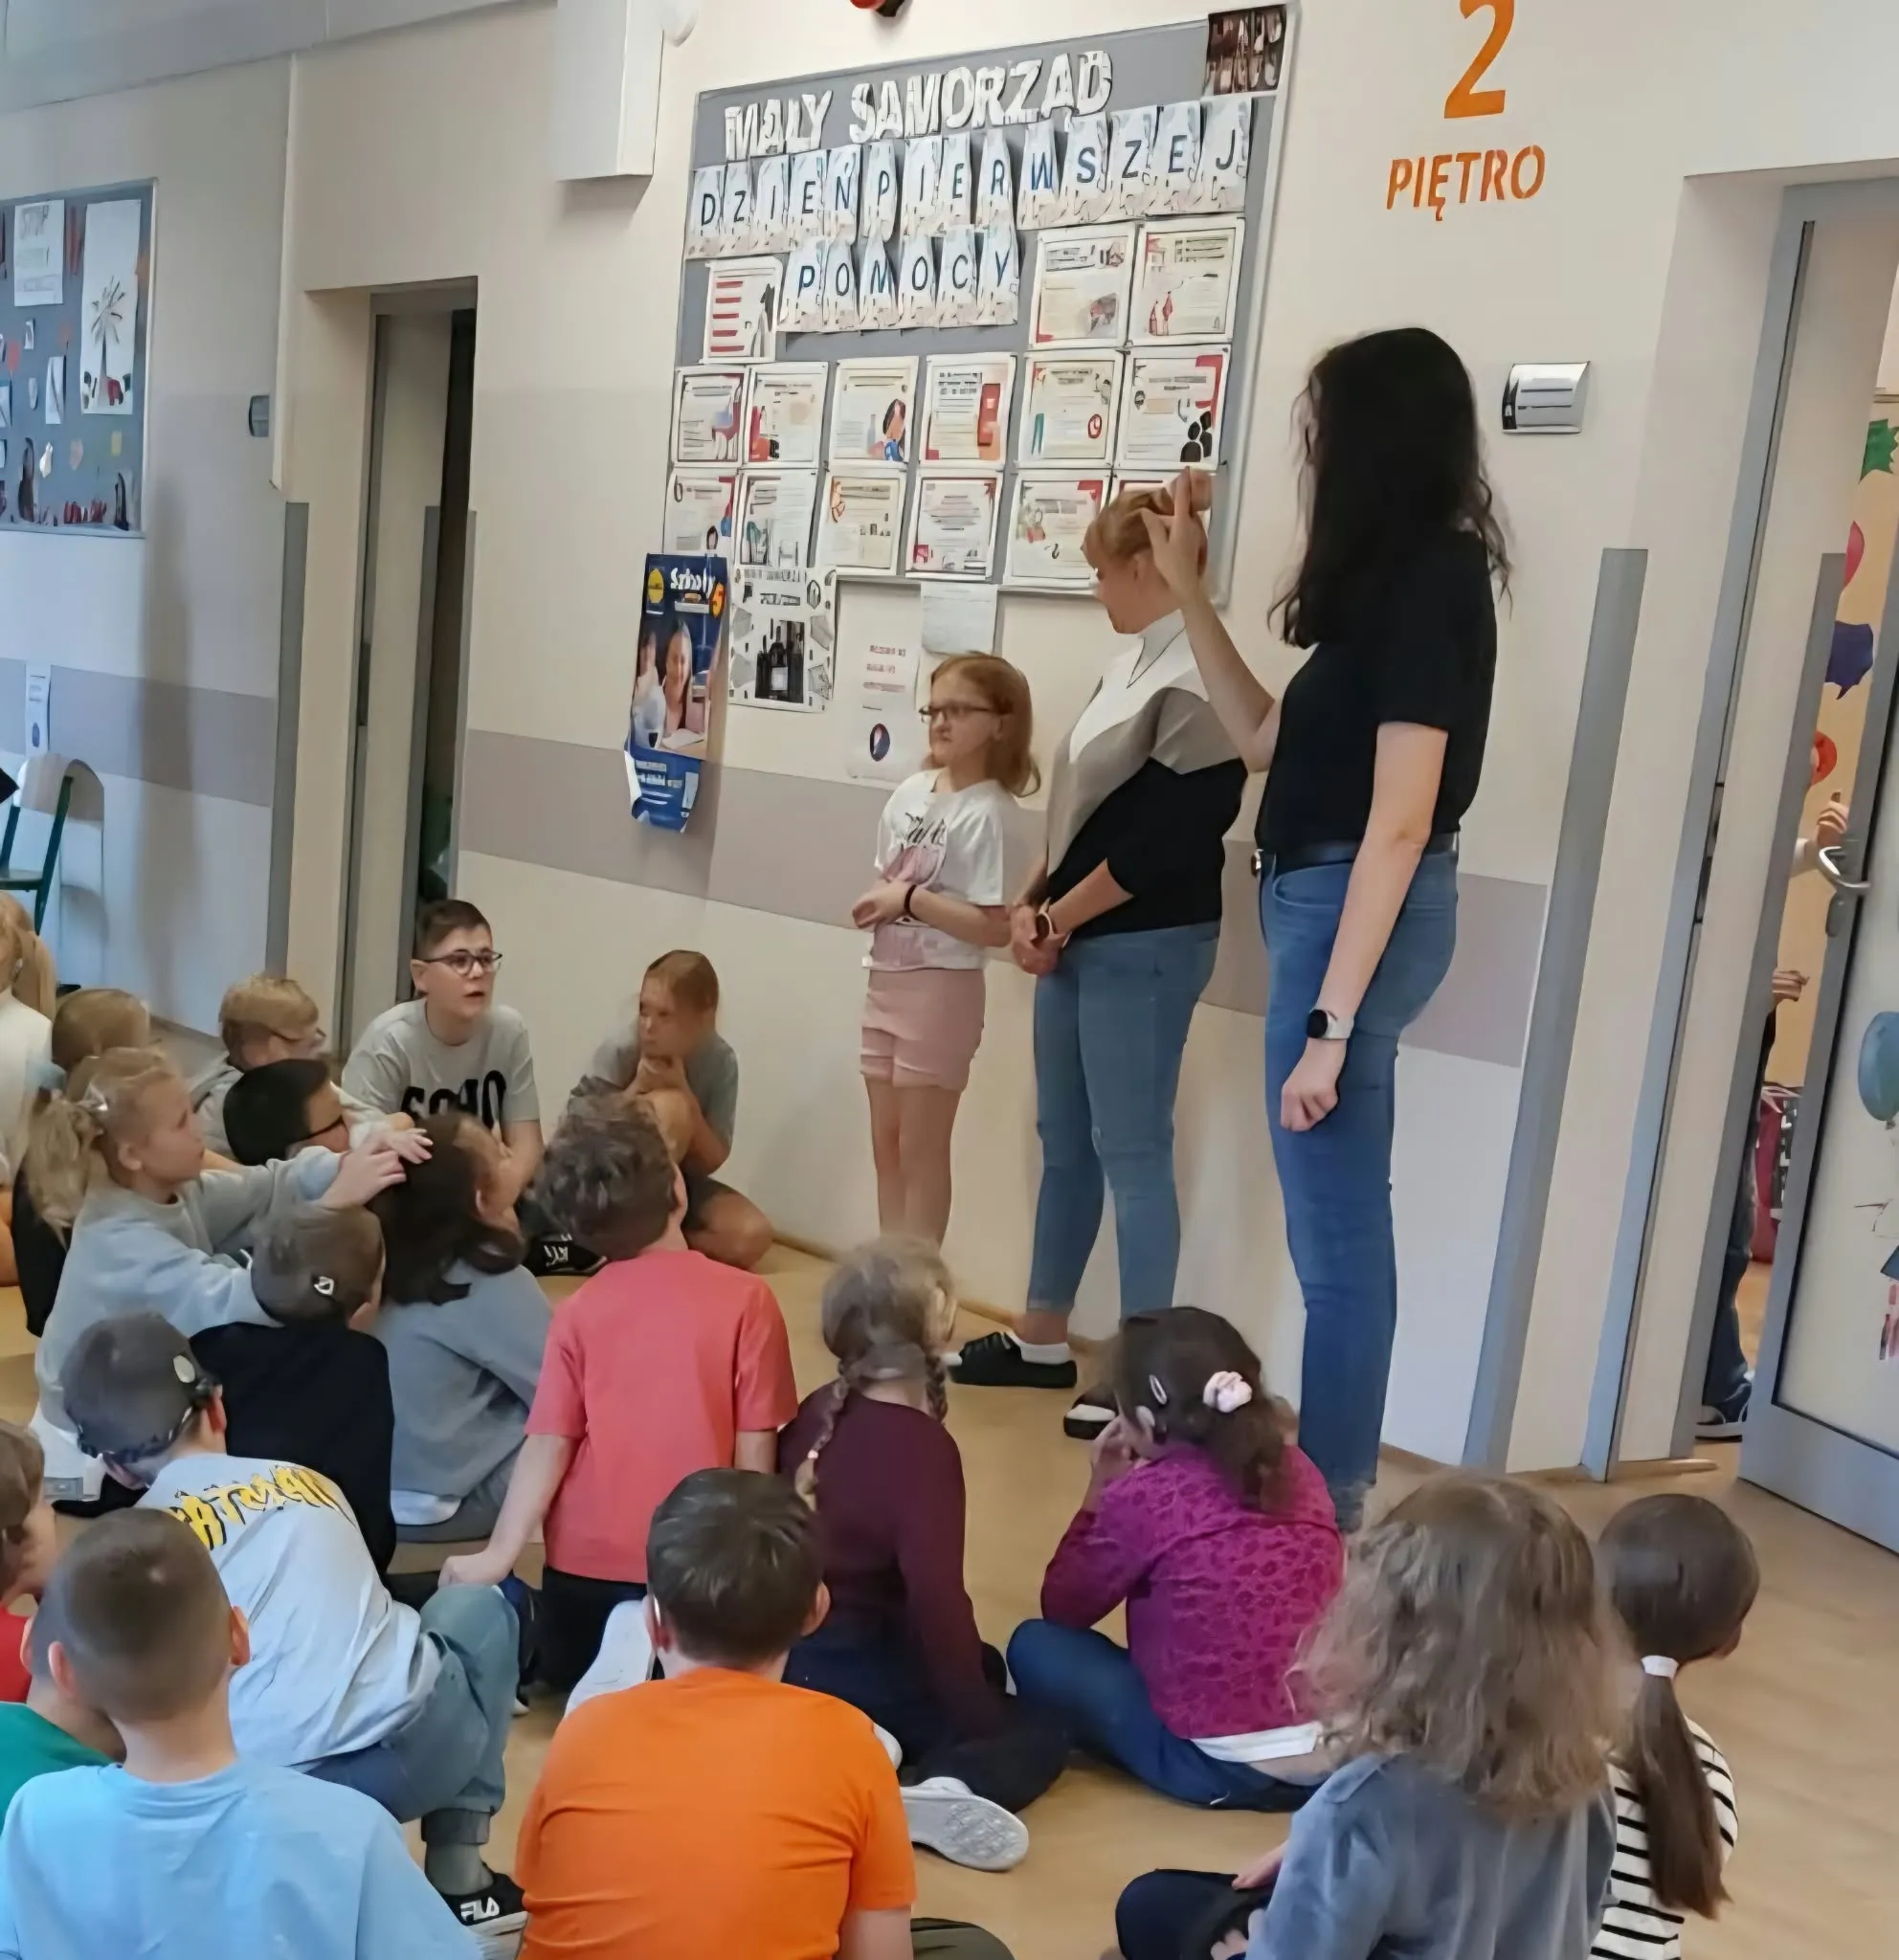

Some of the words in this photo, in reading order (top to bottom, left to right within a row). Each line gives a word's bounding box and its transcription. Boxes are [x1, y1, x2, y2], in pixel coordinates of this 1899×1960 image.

[1443, 0, 1515, 120] 2
[878, 129, 1236, 208] PIERWSZEJ
[1386, 145, 1546, 221] PIĘTRO
[797, 251, 1010, 299] POMOCY
